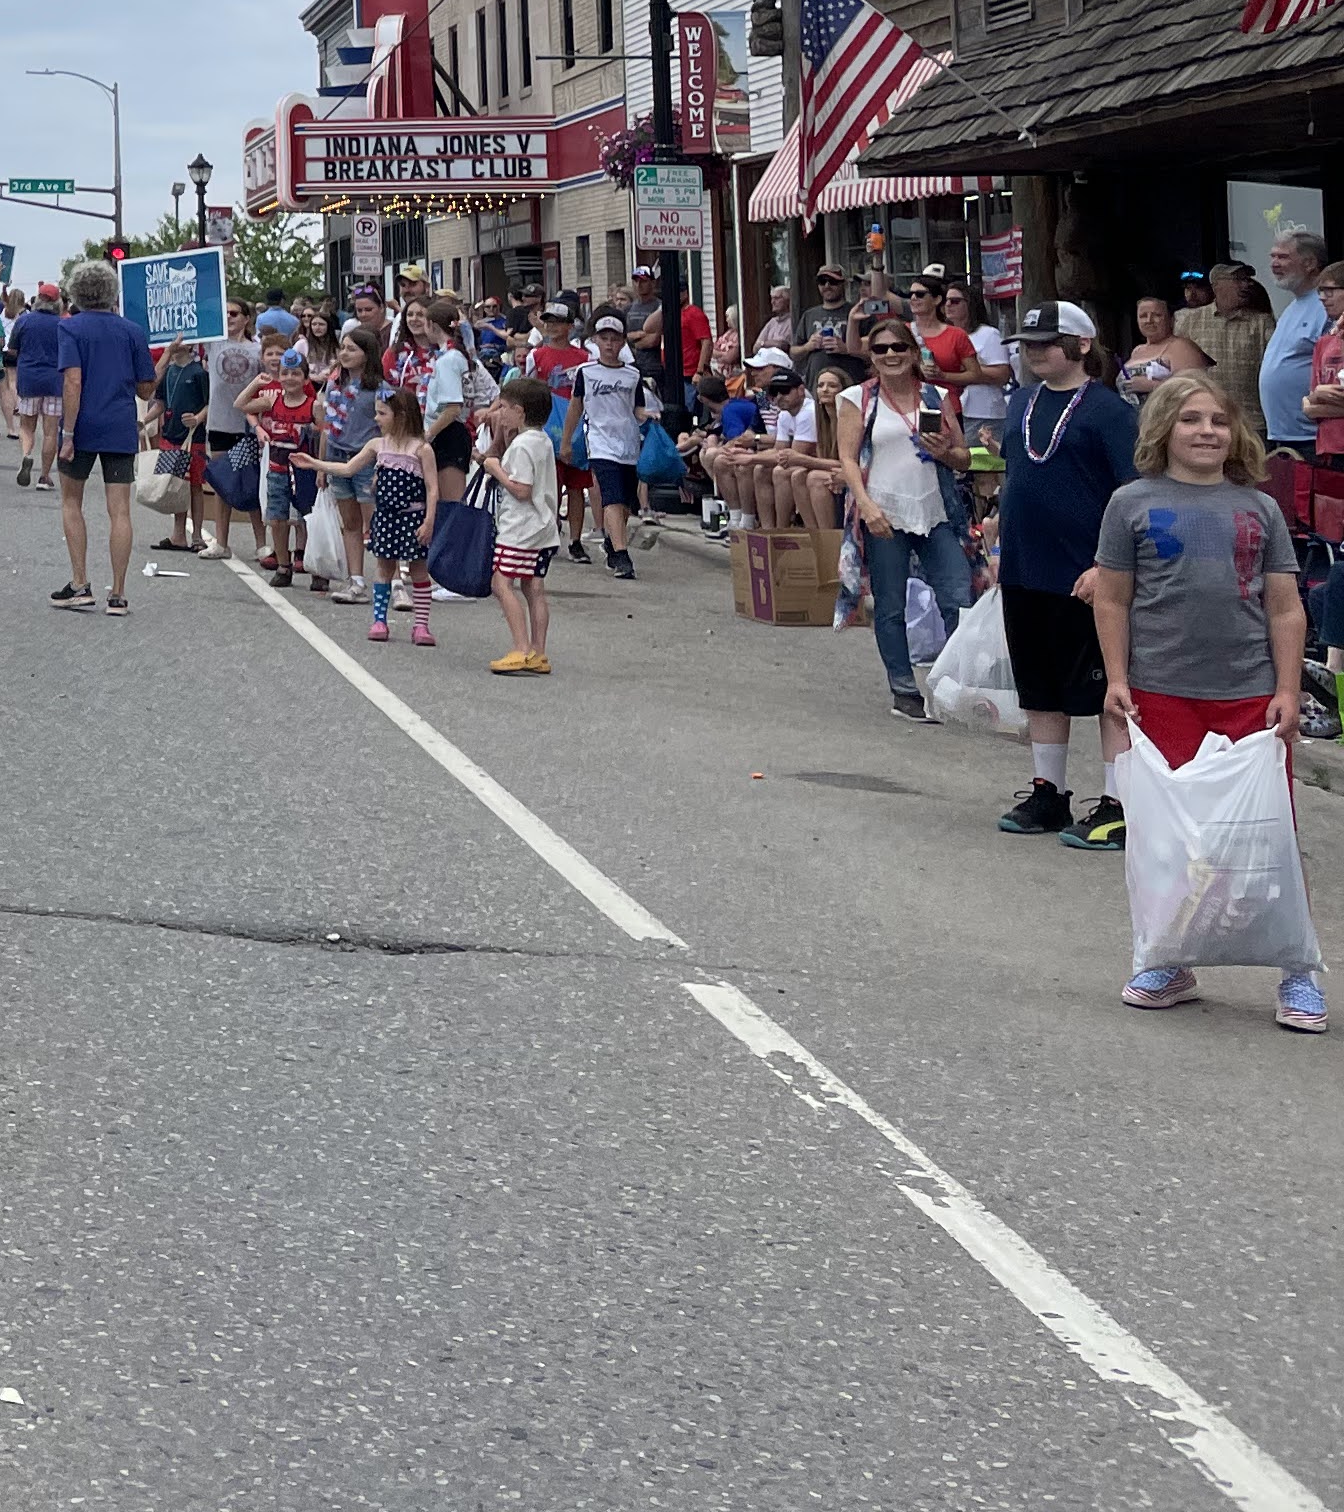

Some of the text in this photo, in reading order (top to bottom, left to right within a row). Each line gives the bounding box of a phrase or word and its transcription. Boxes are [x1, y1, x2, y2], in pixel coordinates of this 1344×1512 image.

[684, 26, 705, 138] WELCOME
[325, 134, 531, 157] INDIANA JONES V
[324, 157, 532, 181] BREAKFAST CLUB
[12, 181, 73, 192] 3rd Ave E
[660, 177, 697, 185] PARKING
[659, 211, 680, 224] NO
[644, 224, 696, 237] PARKING
[652, 237, 666, 245] AM
[686, 237, 699, 245] AM
[145, 261, 170, 285] SAVE
[146, 278, 197, 308] BOUNDARY
[147, 303, 198, 333] WATERS
